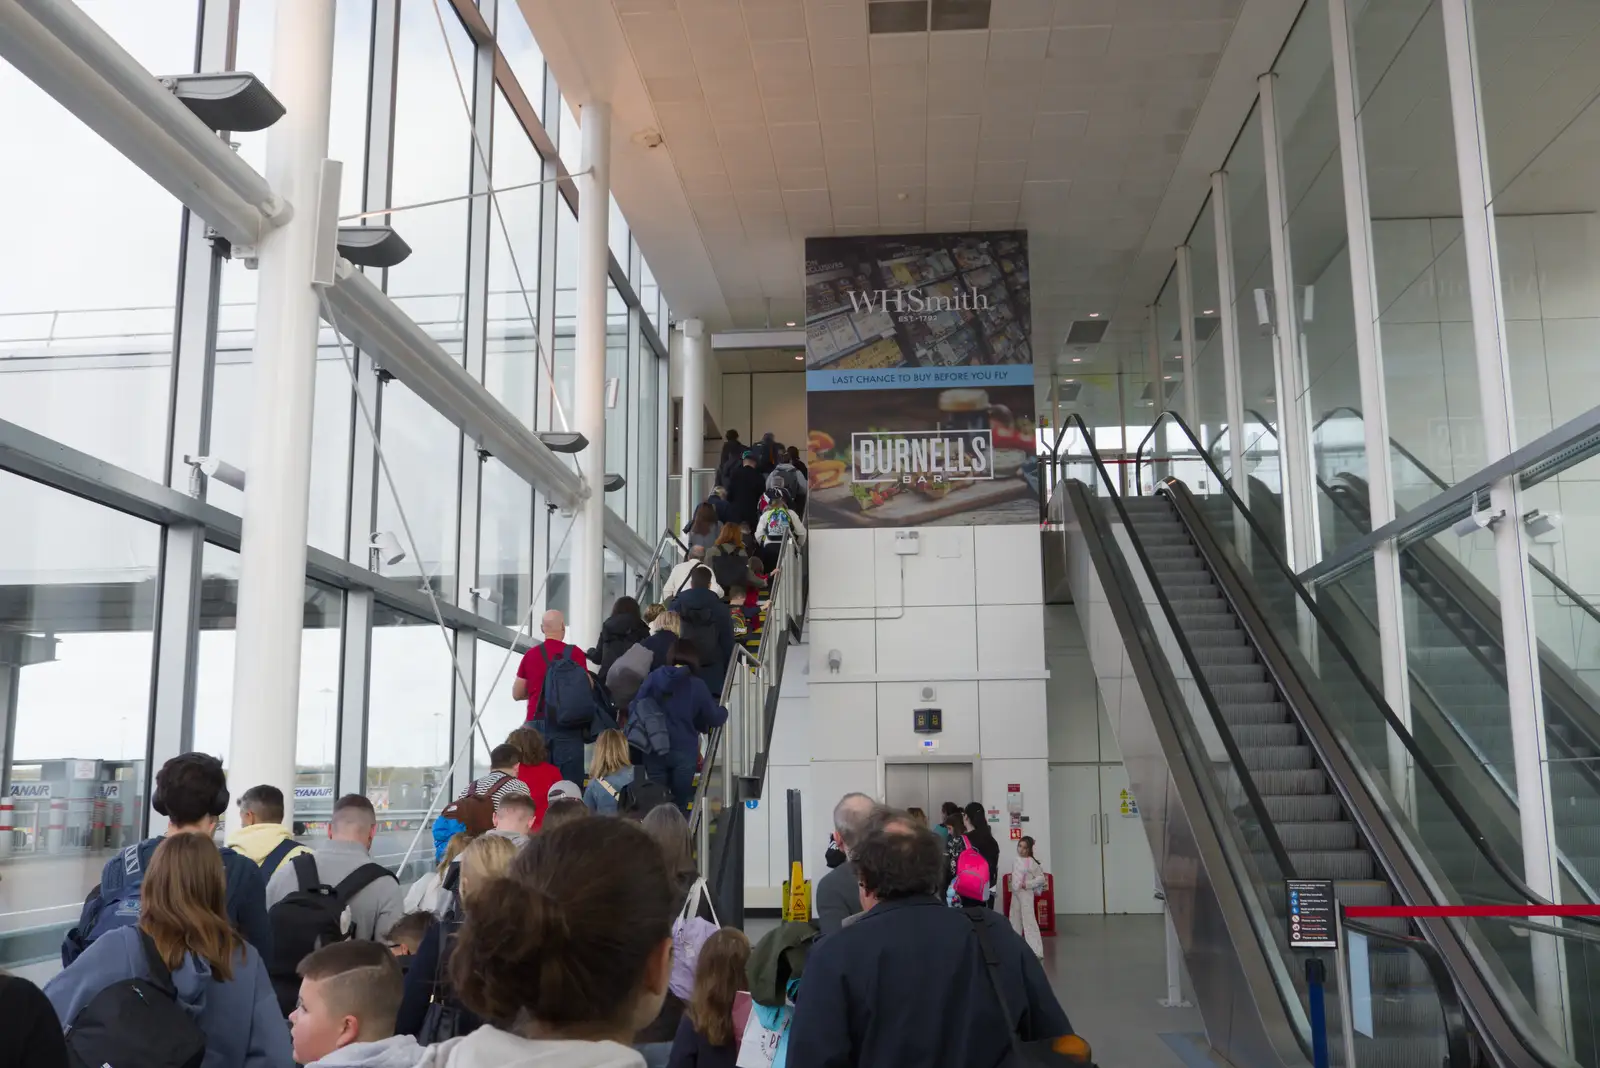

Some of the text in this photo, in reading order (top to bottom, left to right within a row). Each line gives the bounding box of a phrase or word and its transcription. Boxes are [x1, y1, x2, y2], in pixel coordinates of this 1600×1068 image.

[848, 286, 990, 314] WHSmith
[832, 371, 1009, 385] LAST CHANCE TO BUY BEFORE YOU FLY
[860, 436, 986, 474] BURNELLS
[902, 475, 944, 484] BAR
[10, 784, 51, 797] YANAIR
